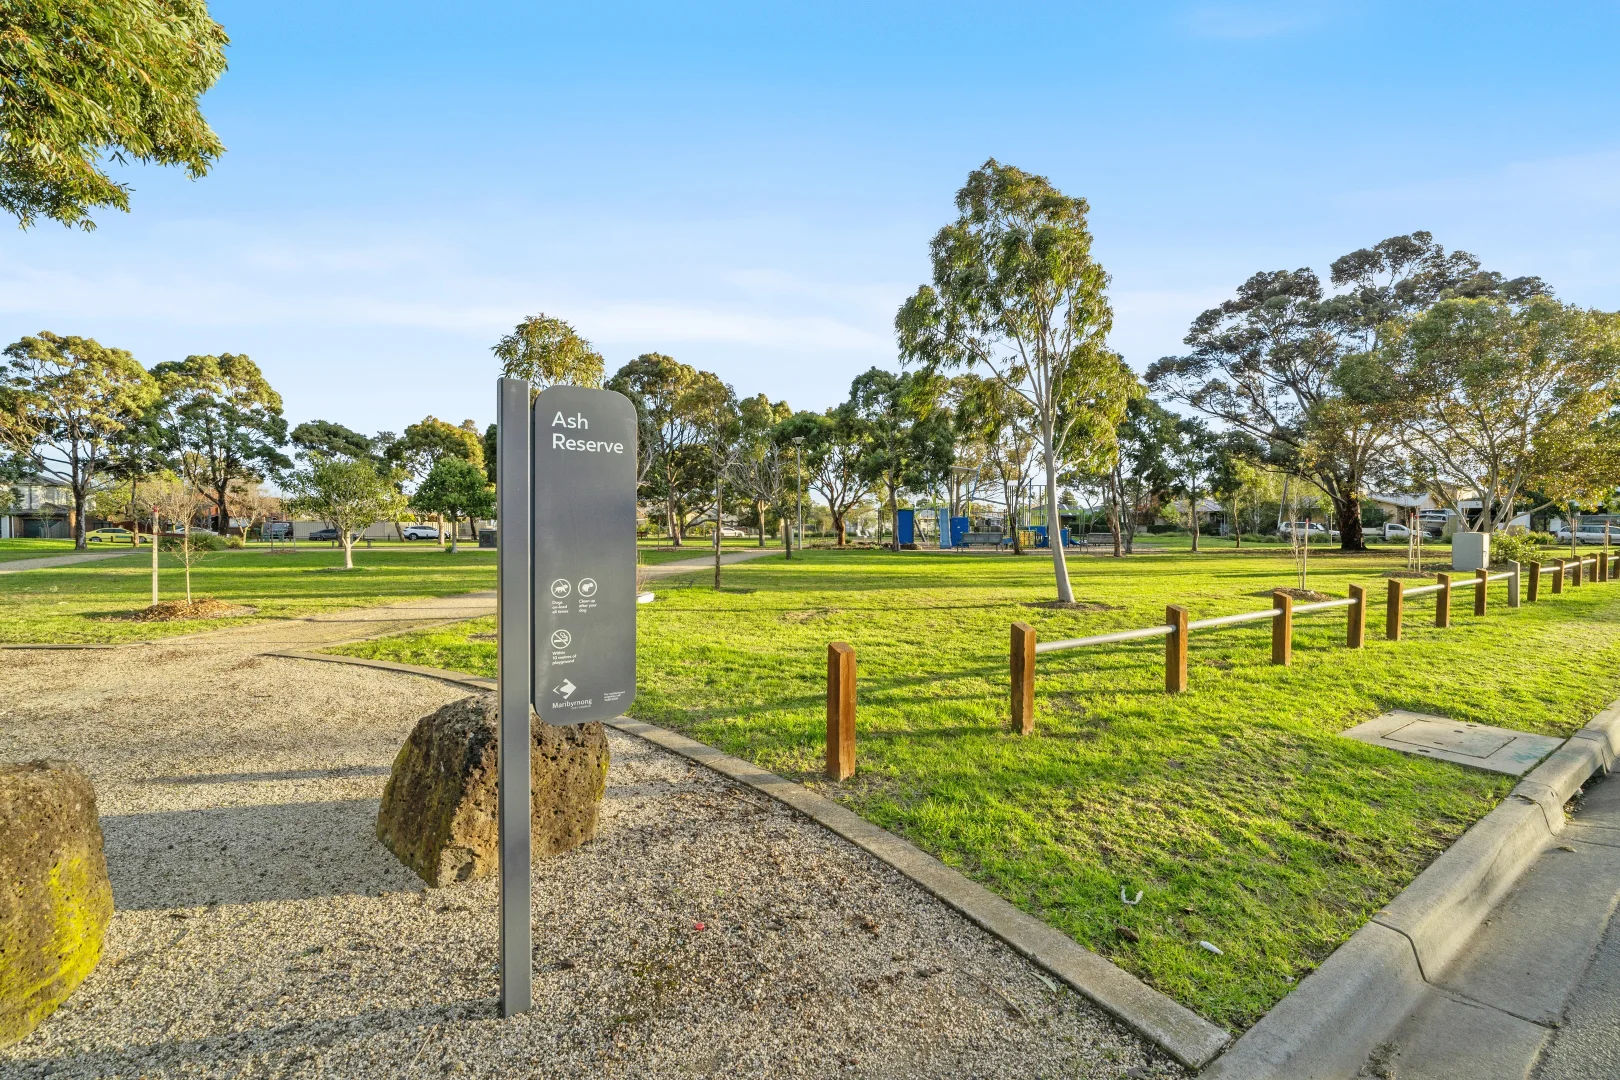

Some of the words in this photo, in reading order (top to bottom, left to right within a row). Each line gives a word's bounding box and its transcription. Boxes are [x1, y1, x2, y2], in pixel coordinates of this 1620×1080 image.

[551, 411, 588, 429] Ash
[552, 433, 624, 454] Reserve
[552, 698, 593, 709] Maribyrnong
